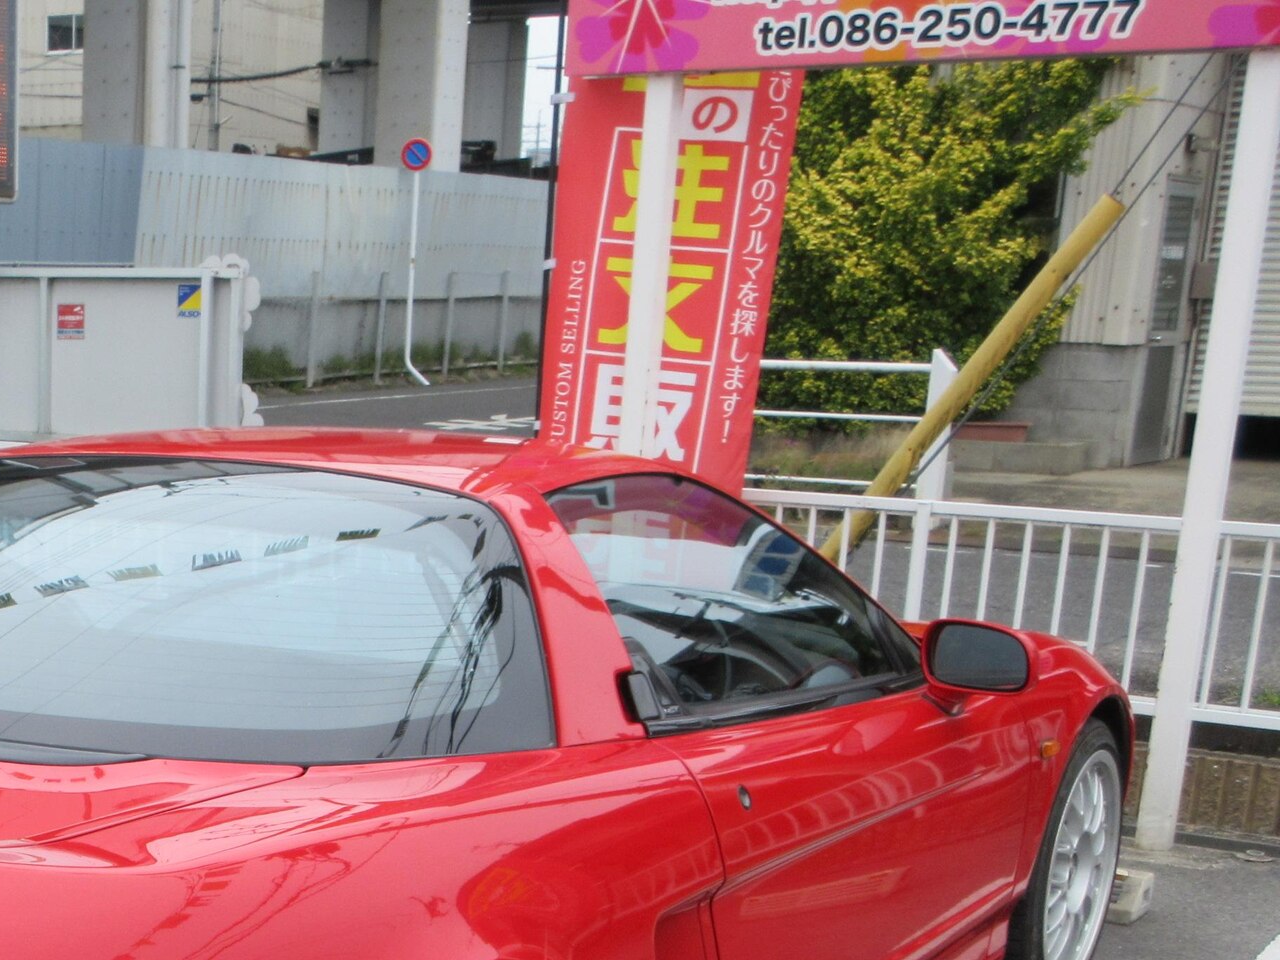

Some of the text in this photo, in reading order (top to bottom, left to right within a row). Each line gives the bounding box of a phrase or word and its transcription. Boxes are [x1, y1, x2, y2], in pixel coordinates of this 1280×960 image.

[758, 0, 1141, 51] tel.086-250-4777
[177, 310, 201, 318] ALSO
[561, 258, 587, 355] SELLING
